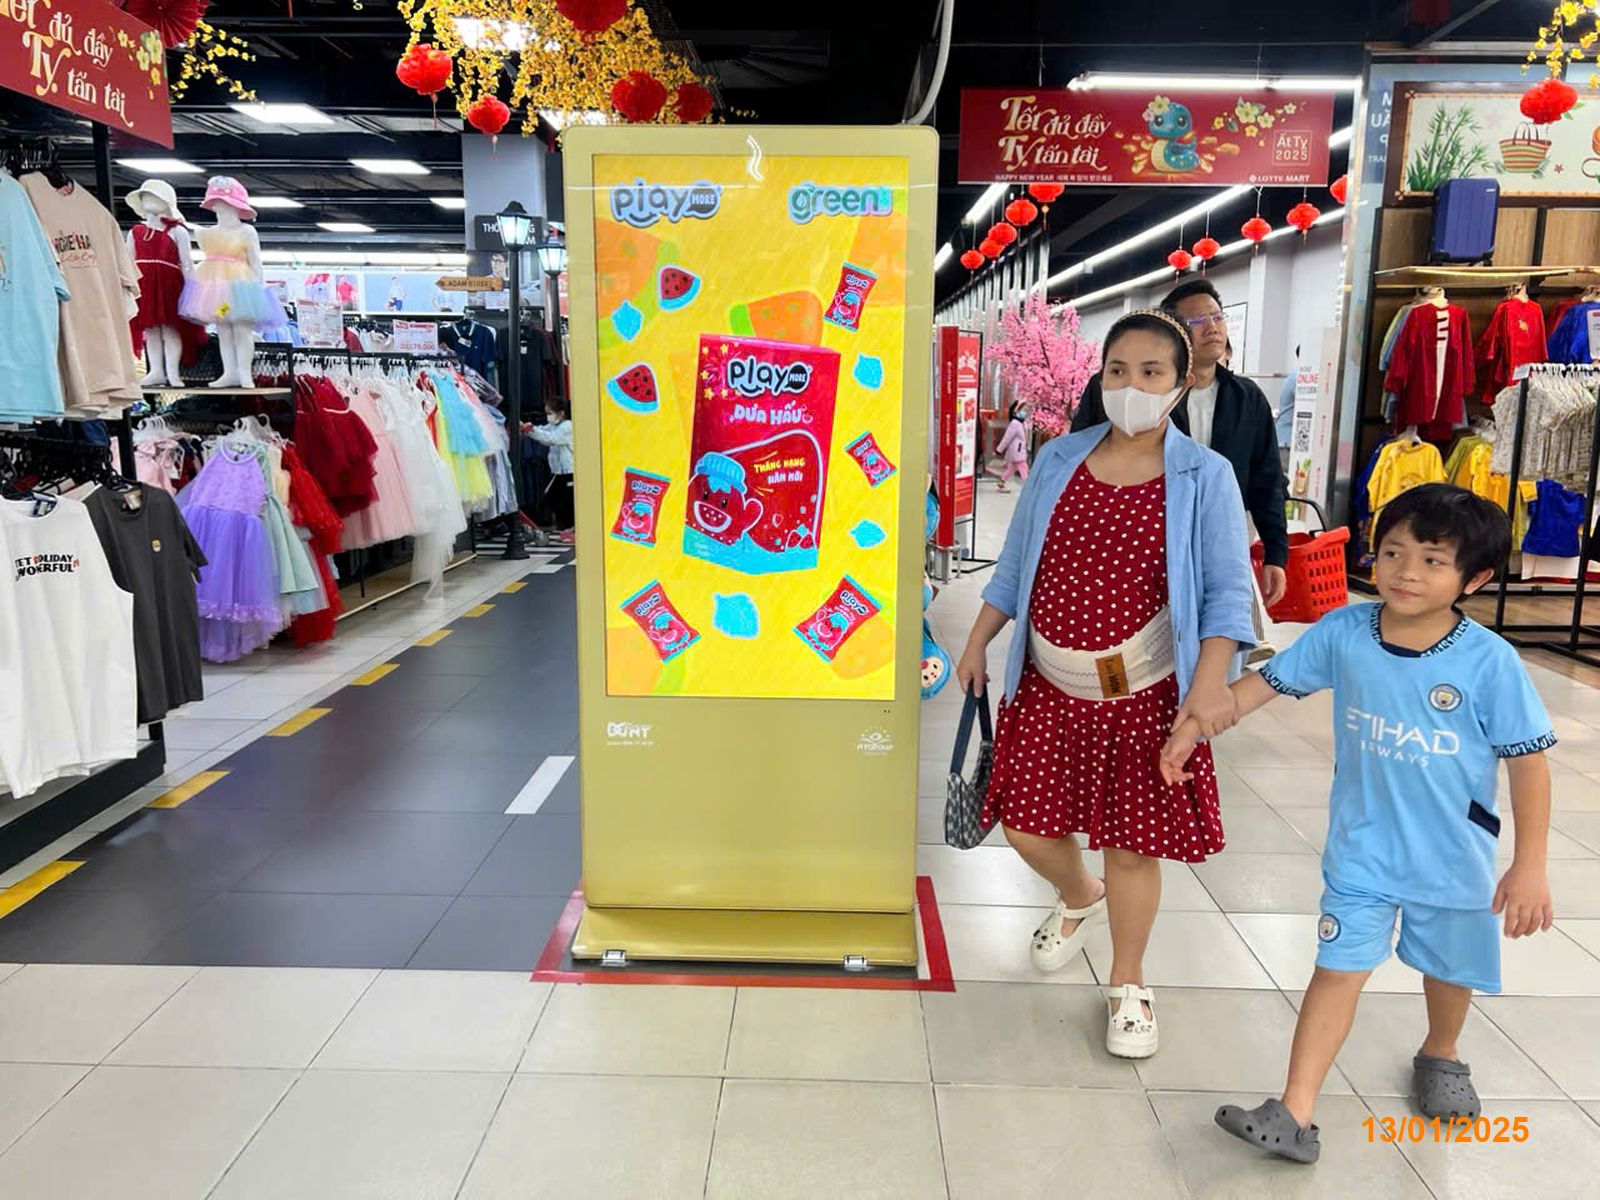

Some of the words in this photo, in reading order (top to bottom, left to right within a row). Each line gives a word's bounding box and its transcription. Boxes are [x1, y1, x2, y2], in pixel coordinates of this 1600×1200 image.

[49, 11, 82, 56] đủ
[1000, 95, 1057, 131] Tết
[1043, 114, 1079, 140] đủ
[1075, 113, 1112, 139] đầy
[1034, 144, 1069, 165] tấn
[1071, 144, 1108, 171] tài
[1275, 149, 1308, 161] 2025
[1257, 175, 1284, 183] LOTTE
[1286, 175, 1310, 183] MART
[691, 194, 716, 205] MORE
[734, 403, 767, 423] DƯA
